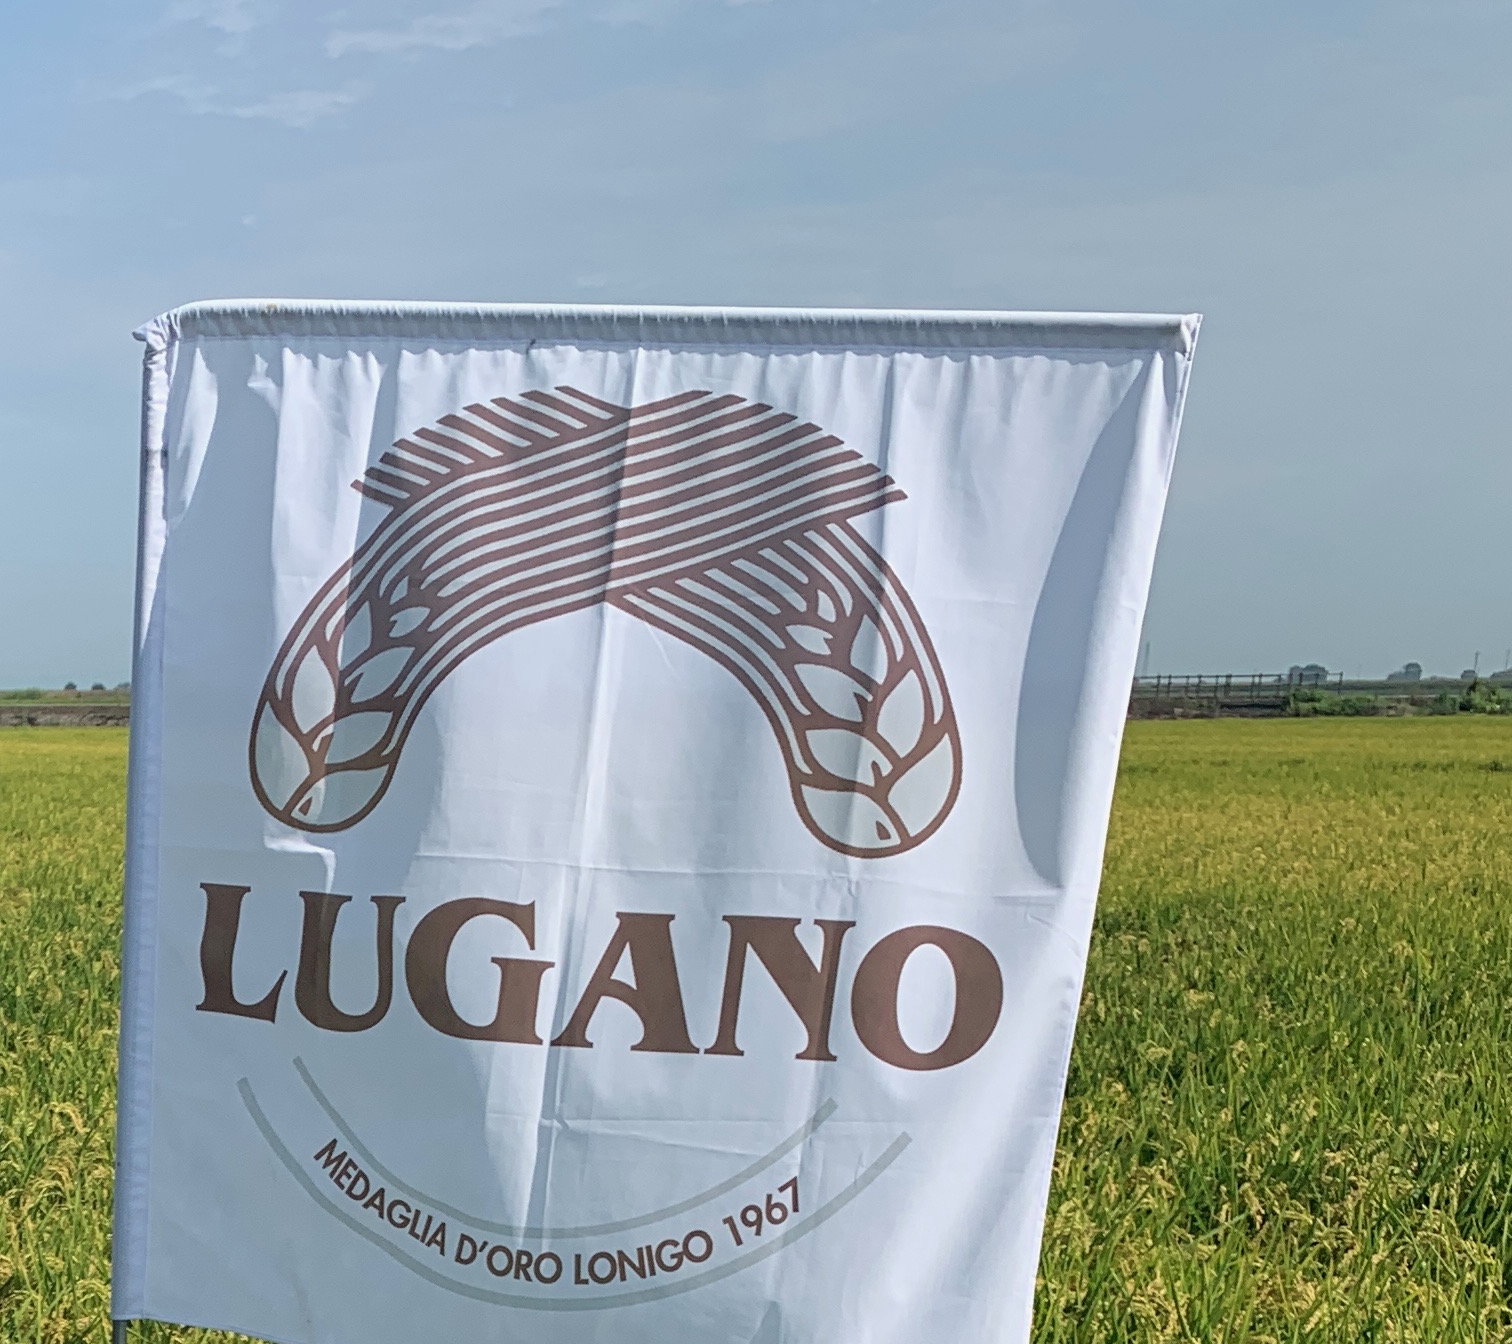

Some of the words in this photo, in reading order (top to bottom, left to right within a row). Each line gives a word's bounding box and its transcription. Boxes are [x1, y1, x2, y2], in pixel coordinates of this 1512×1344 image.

[194, 881, 1005, 1072] LUGANO
[313, 1138, 447, 1257] MEDAGLIA
[454, 1232, 563, 1286] D'ORO
[574, 1229, 714, 1286] LONIGO
[722, 1176, 800, 1247] 1967
